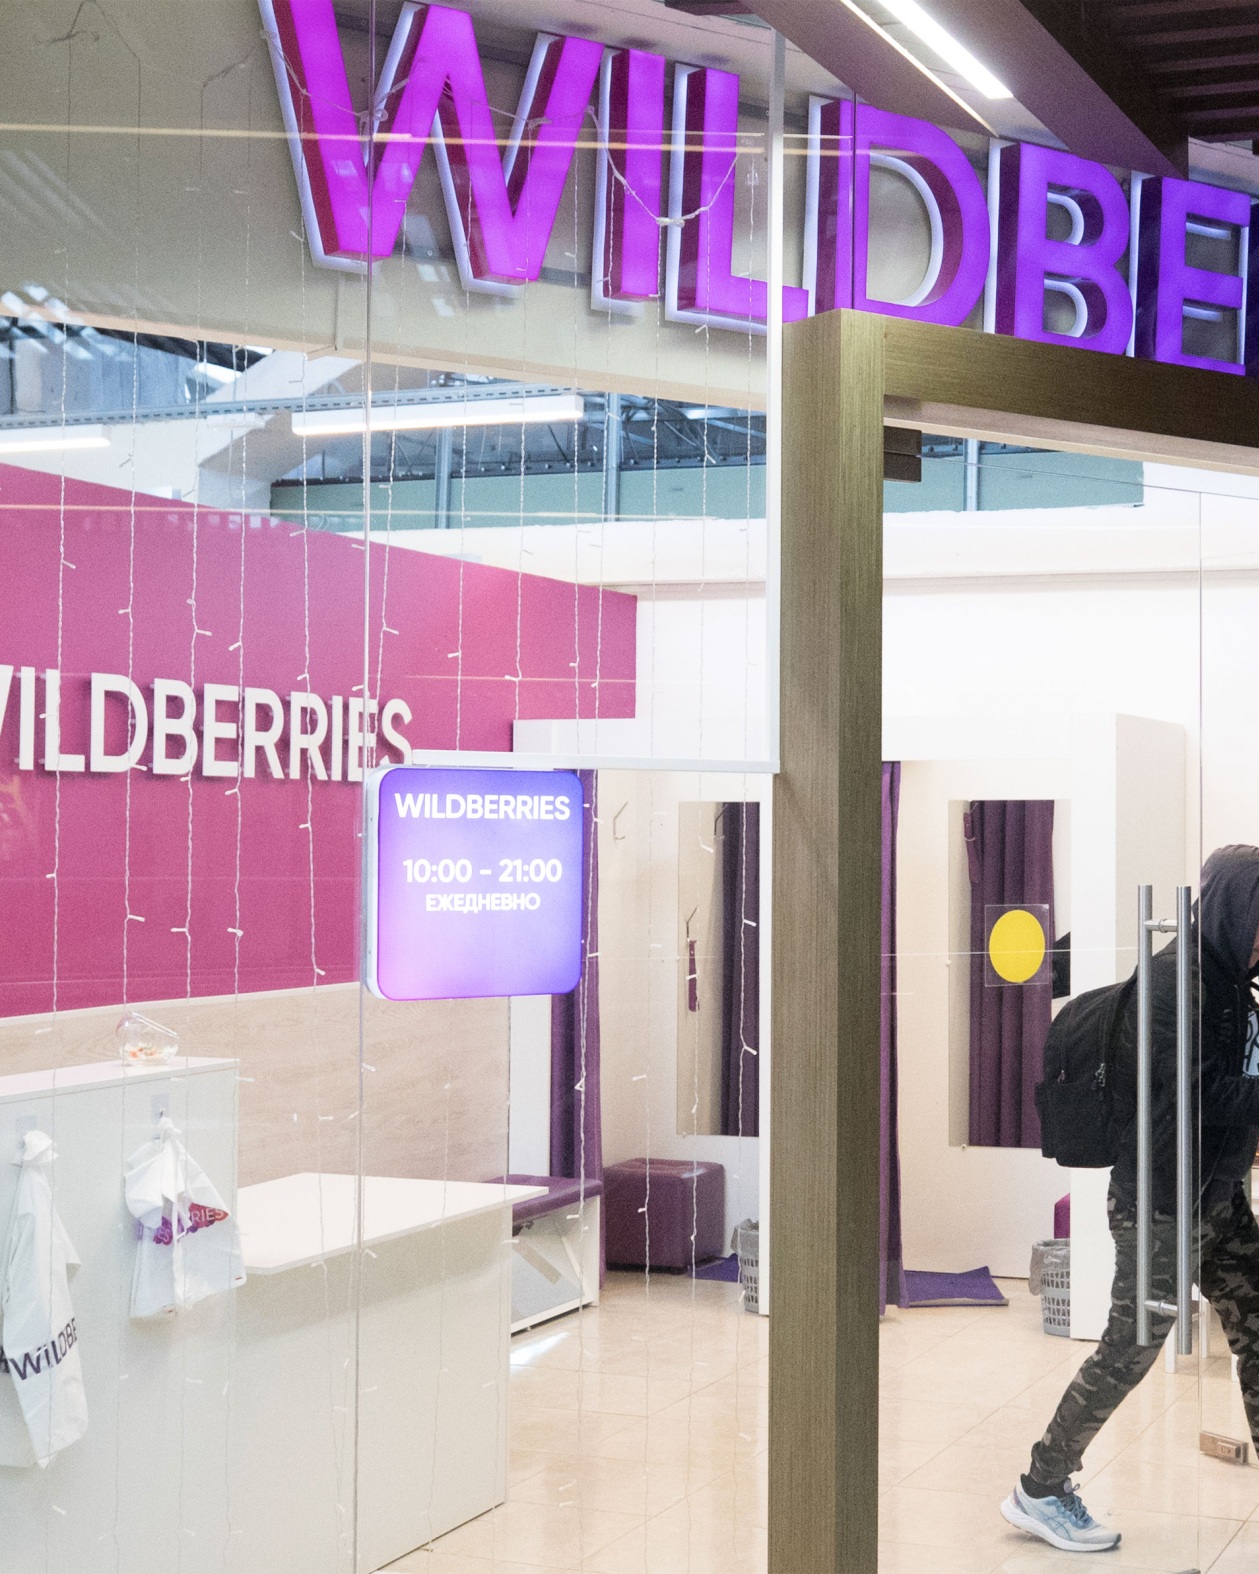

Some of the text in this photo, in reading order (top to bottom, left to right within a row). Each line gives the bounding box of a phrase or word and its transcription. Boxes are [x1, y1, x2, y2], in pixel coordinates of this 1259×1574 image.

[394, 793, 571, 821] WILDBERRIES
[402, 858, 473, 884] 10:00
[498, 858, 563, 883] 21:00
[425, 892, 541, 914] ЕЖЕДНЕВНО
